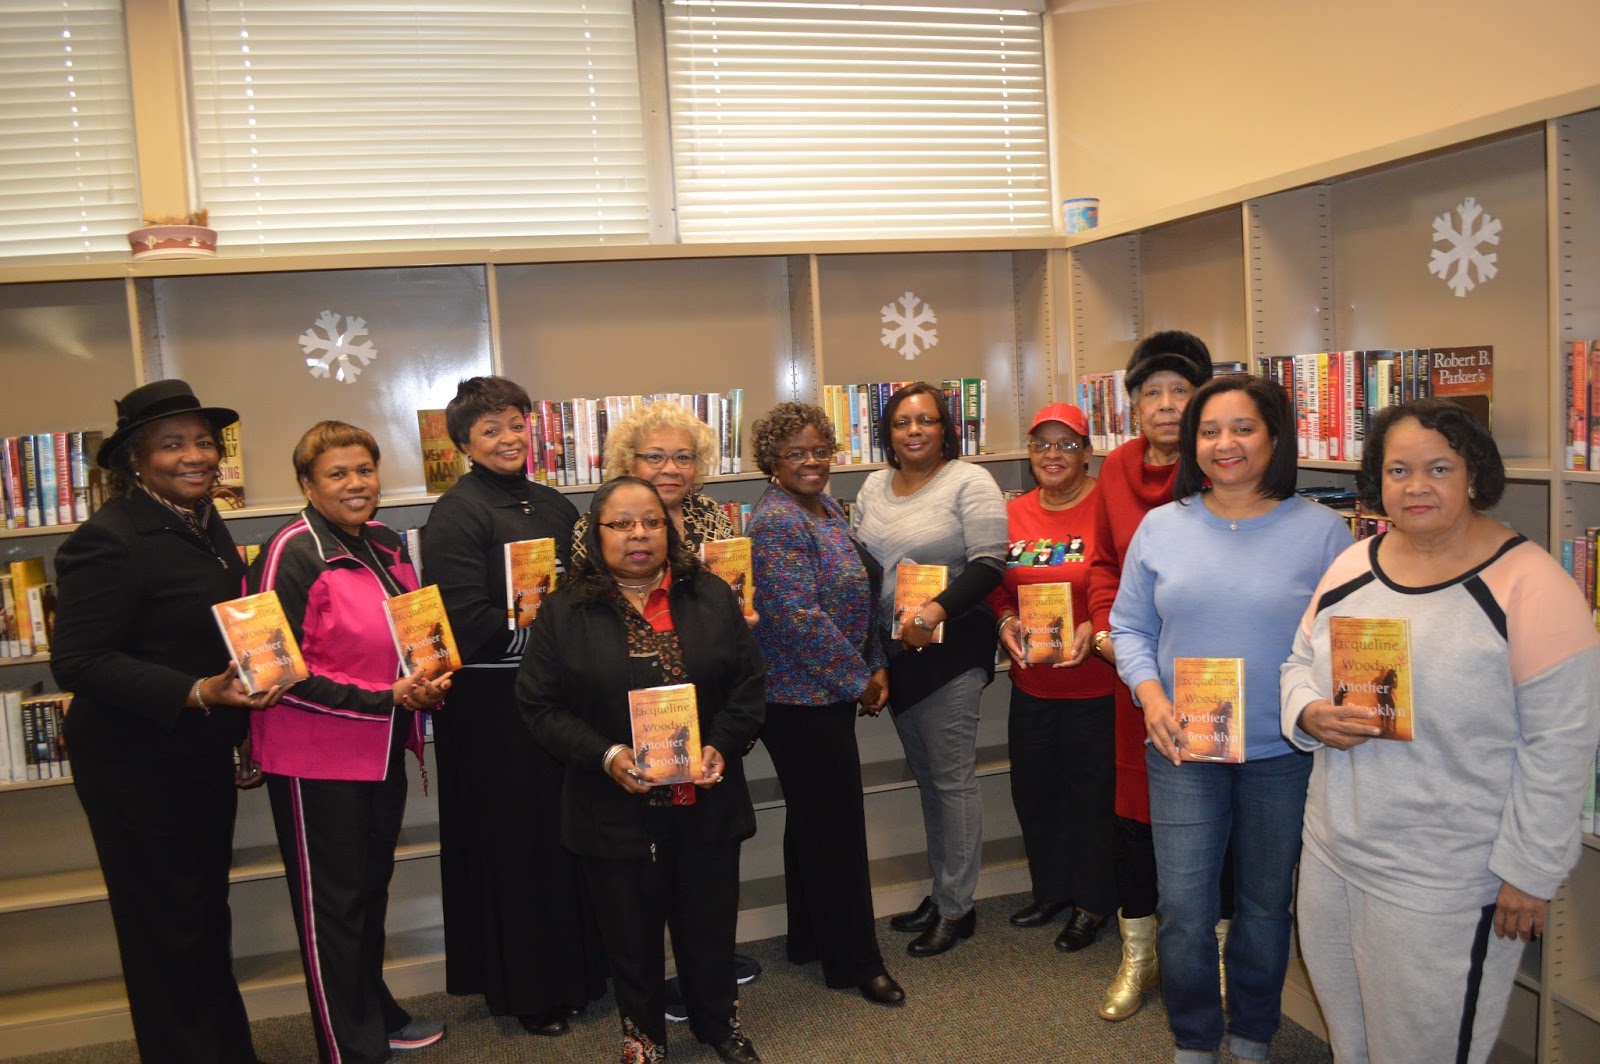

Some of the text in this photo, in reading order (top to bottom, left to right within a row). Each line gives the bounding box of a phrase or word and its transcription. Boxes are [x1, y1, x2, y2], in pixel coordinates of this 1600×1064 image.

[1433, 352, 1476, 368] Robert
[1478, 350, 1491, 366] B.
[1438, 369, 1485, 385] Parker's
[968, 383, 977, 395] TOM
[1355, 385, 1364, 408] KING
[968, 396, 977, 417] CLANCY
[24, 441, 36, 489] DAVID BALDACCI
[56, 435, 69, 500] DAVID BALDACCI
[512, 555, 552, 568] Jacqueline
[516, 585, 547, 597] Another
[1022, 597, 1065, 607] Jacqueline
[392, 602, 438, 621] Jacqueline
[1028, 611, 1066, 619] Woodson
[402, 615, 444, 634] Woodson
[1025, 625, 1060, 634] Another
[241, 640, 282, 659] Another
[405, 634, 440, 652] Another
[1031, 640, 1069, 650] Brooklyn
[1332, 638, 1399, 652] Jacqueline
[415, 646, 455, 665] Brooklyn
[254, 654, 299, 673] Brooklyn
[1341, 658, 1402, 673] Woodson
[1176, 675, 1235, 687] Jacqueline
[1337, 681, 1390, 694] Another
[1185, 693, 1237, 703] Woodson
[633, 703, 690, 719] Jacqueline
[1179, 712, 1226, 723] Another
[642, 720, 693, 732] Woodson
[640, 738, 684, 751] Another
[1187, 732, 1239, 745] Brooklyn
[649, 754, 697, 768] Brooklyn
